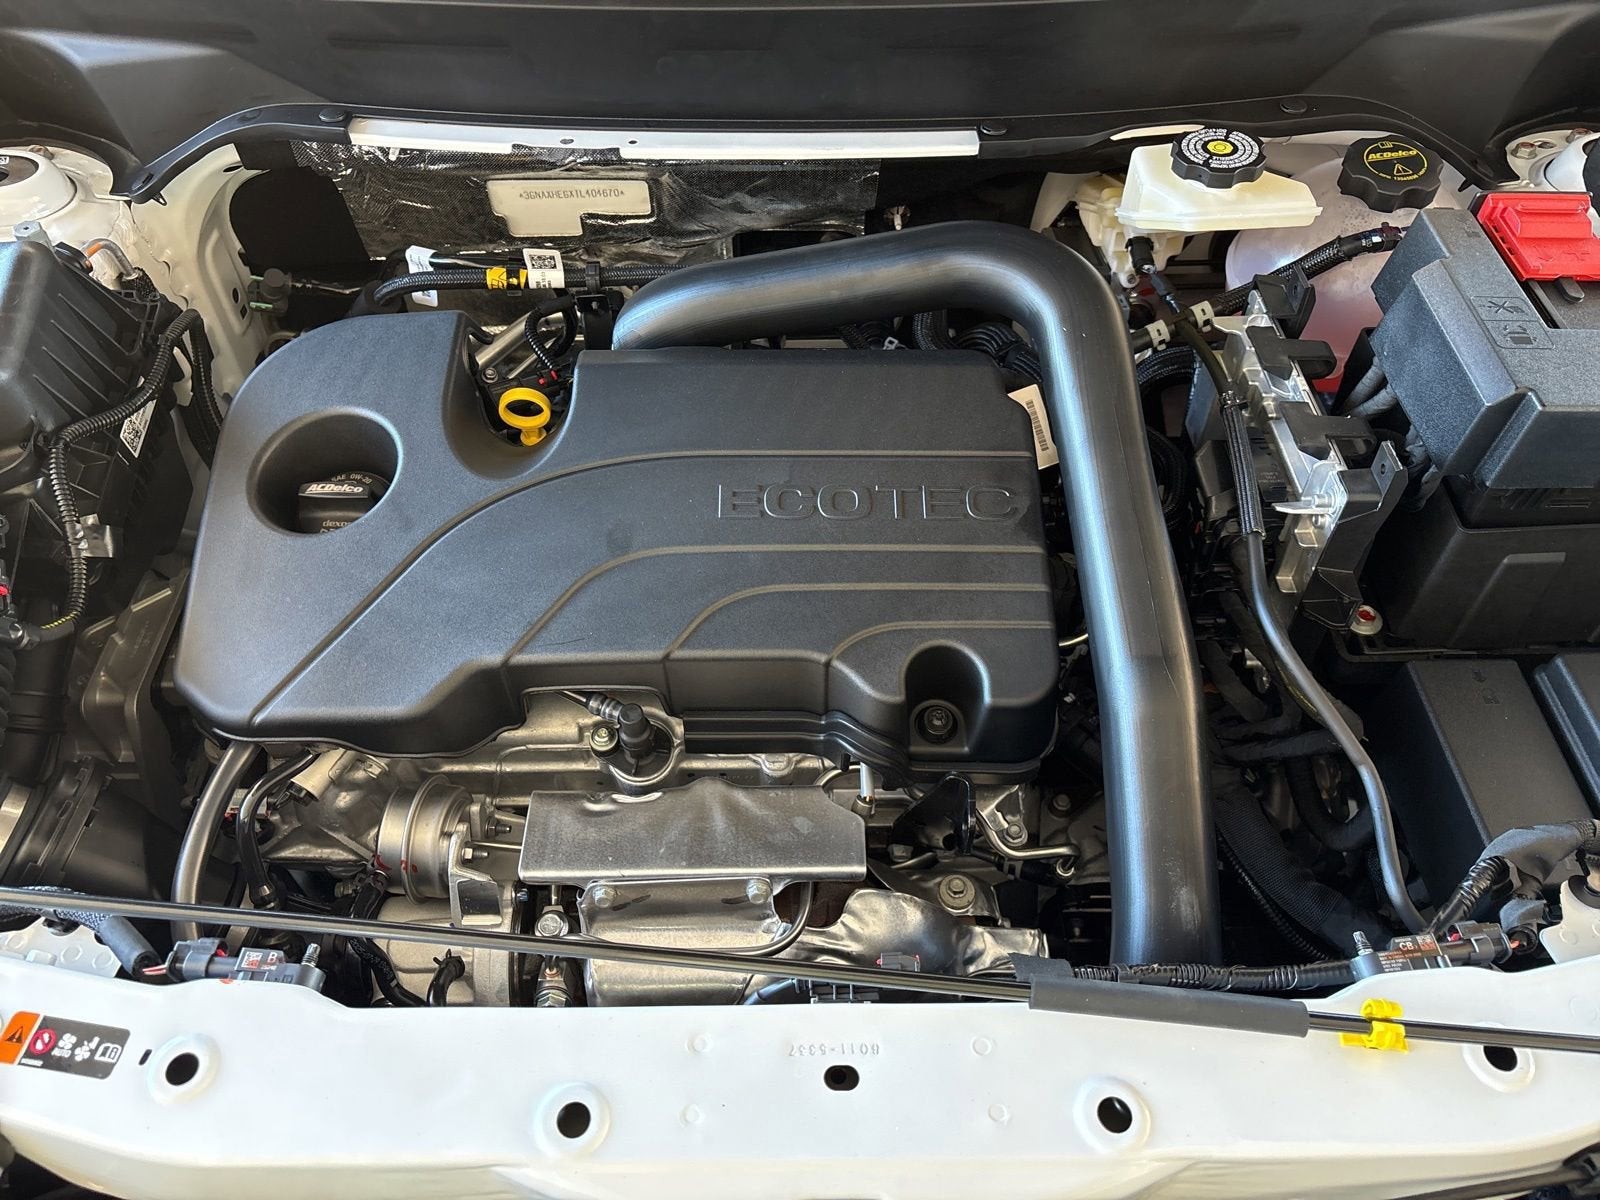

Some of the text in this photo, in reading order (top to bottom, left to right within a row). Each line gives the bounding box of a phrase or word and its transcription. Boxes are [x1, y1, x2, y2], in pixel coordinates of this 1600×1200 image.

[1368, 150, 1417, 161] ACDelco
[350, 473, 373, 485] 0W-20
[305, 483, 364, 493] ACDelco
[718, 484, 1017, 520] ECOTEC
